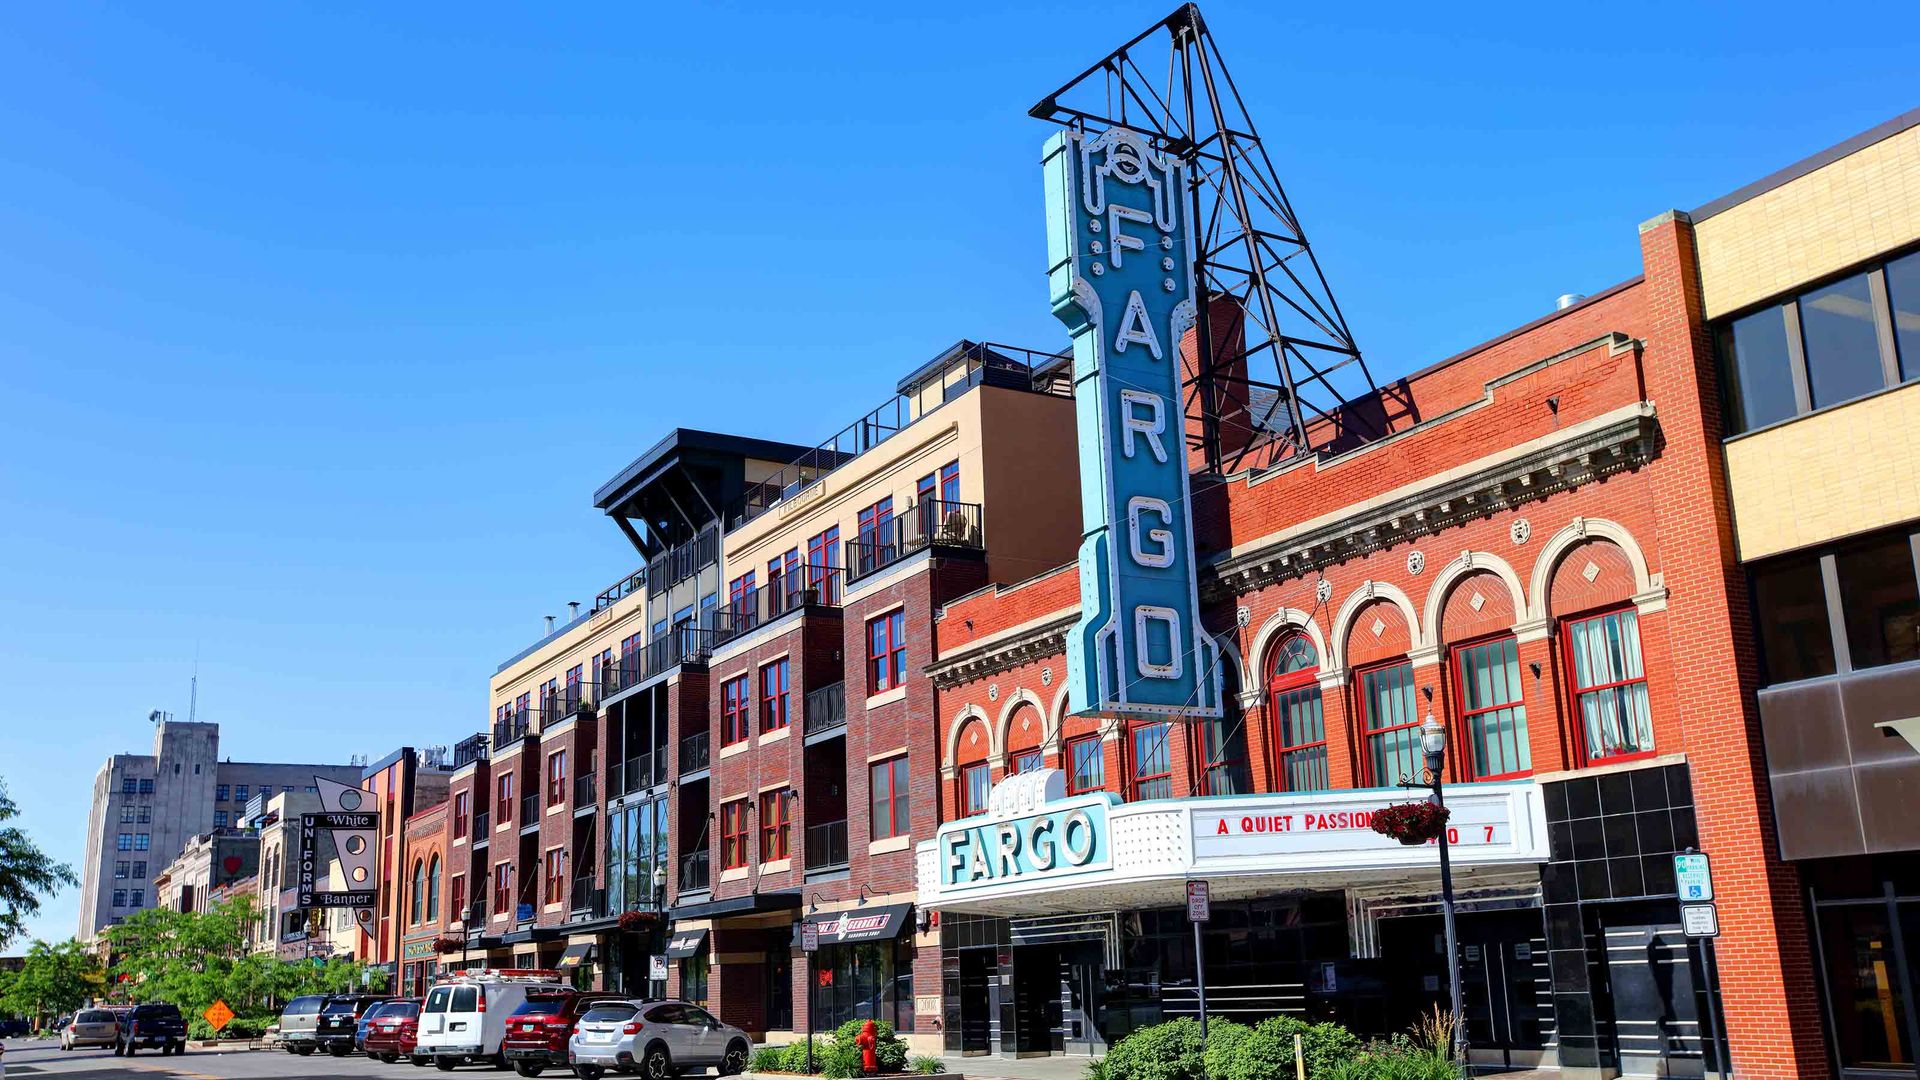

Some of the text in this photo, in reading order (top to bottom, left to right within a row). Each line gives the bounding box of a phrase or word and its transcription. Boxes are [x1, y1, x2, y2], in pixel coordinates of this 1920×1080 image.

[1108, 203, 1183, 680] FARGO
[326, 815, 369, 827] White
[1217, 811, 1376, 835] A QUIET PASSION
[1484, 826, 1494, 843] 7
[946, 809, 1097, 885] FARGO
[302, 817, 315, 905] UNIFORMS
[320, 894, 371, 905] Banner
